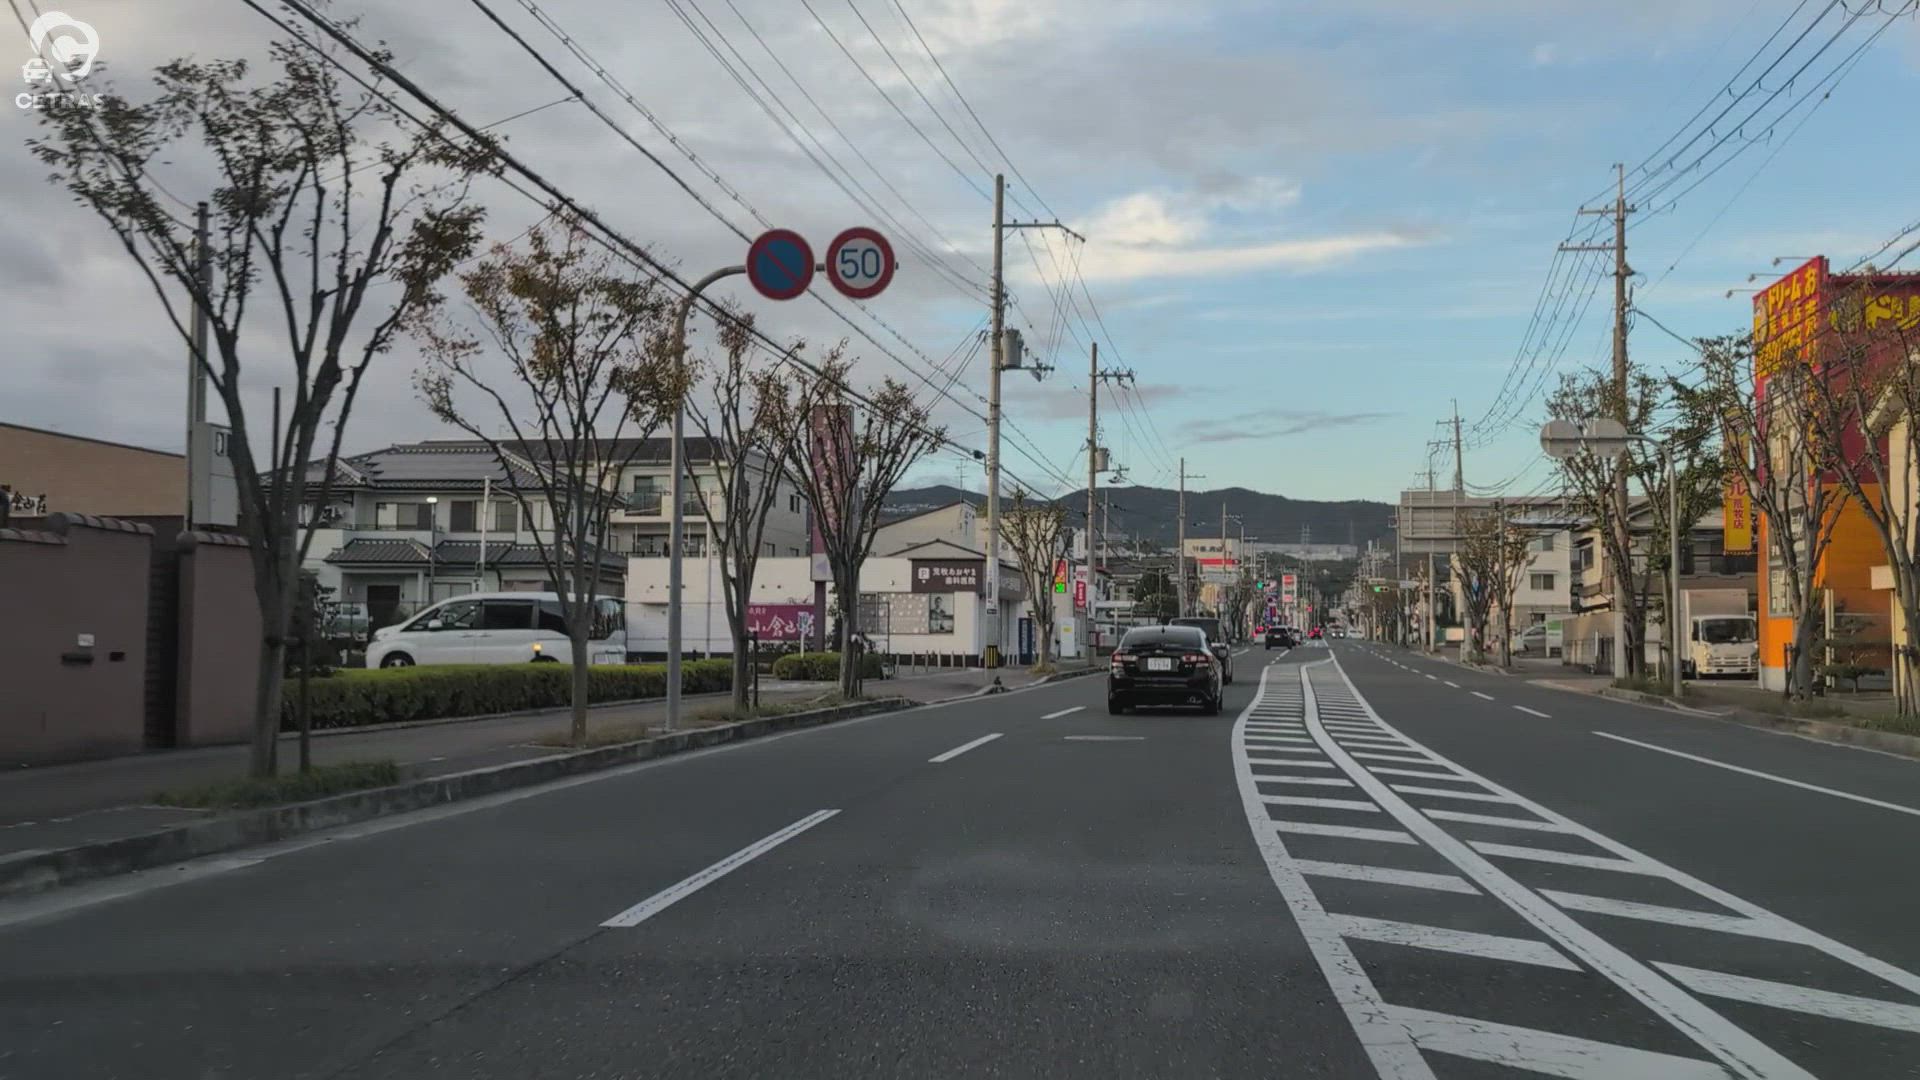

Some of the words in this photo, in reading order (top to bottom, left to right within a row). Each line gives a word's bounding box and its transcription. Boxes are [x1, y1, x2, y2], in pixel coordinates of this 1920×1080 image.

[841, 248, 880, 279] 50
[1768, 274, 1802, 316] ドリーム
